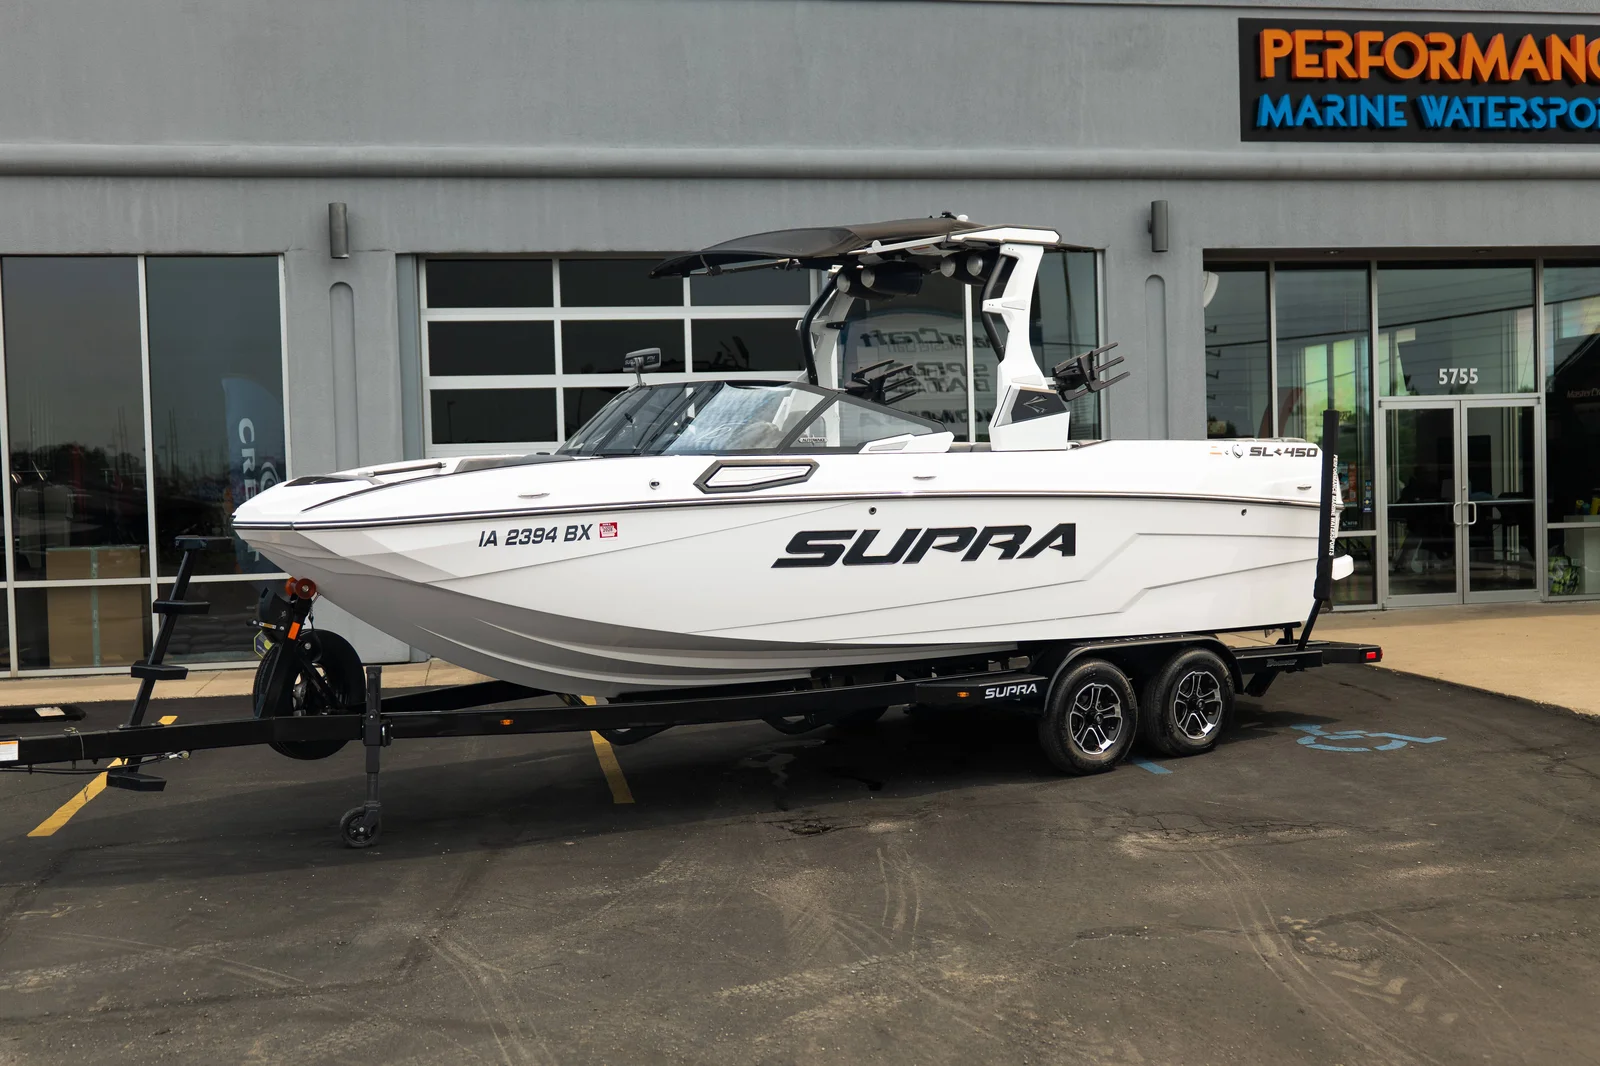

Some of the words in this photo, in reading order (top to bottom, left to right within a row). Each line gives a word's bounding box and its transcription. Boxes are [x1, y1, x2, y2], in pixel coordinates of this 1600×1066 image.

[1257, 93, 1407, 127] MARINE
[1416, 95, 1600, 129] WATERSPO
[1438, 368, 1479, 385] 5755
[1249, 447, 1273, 457] SL
[1284, 447, 1318, 458] 450
[478, 530, 498, 547] IA
[505, 526, 558, 546] 2394
[563, 524, 593, 542] BX
[770, 523, 1076, 568] SUPRA
[984, 683, 1037, 699] SUPRA
